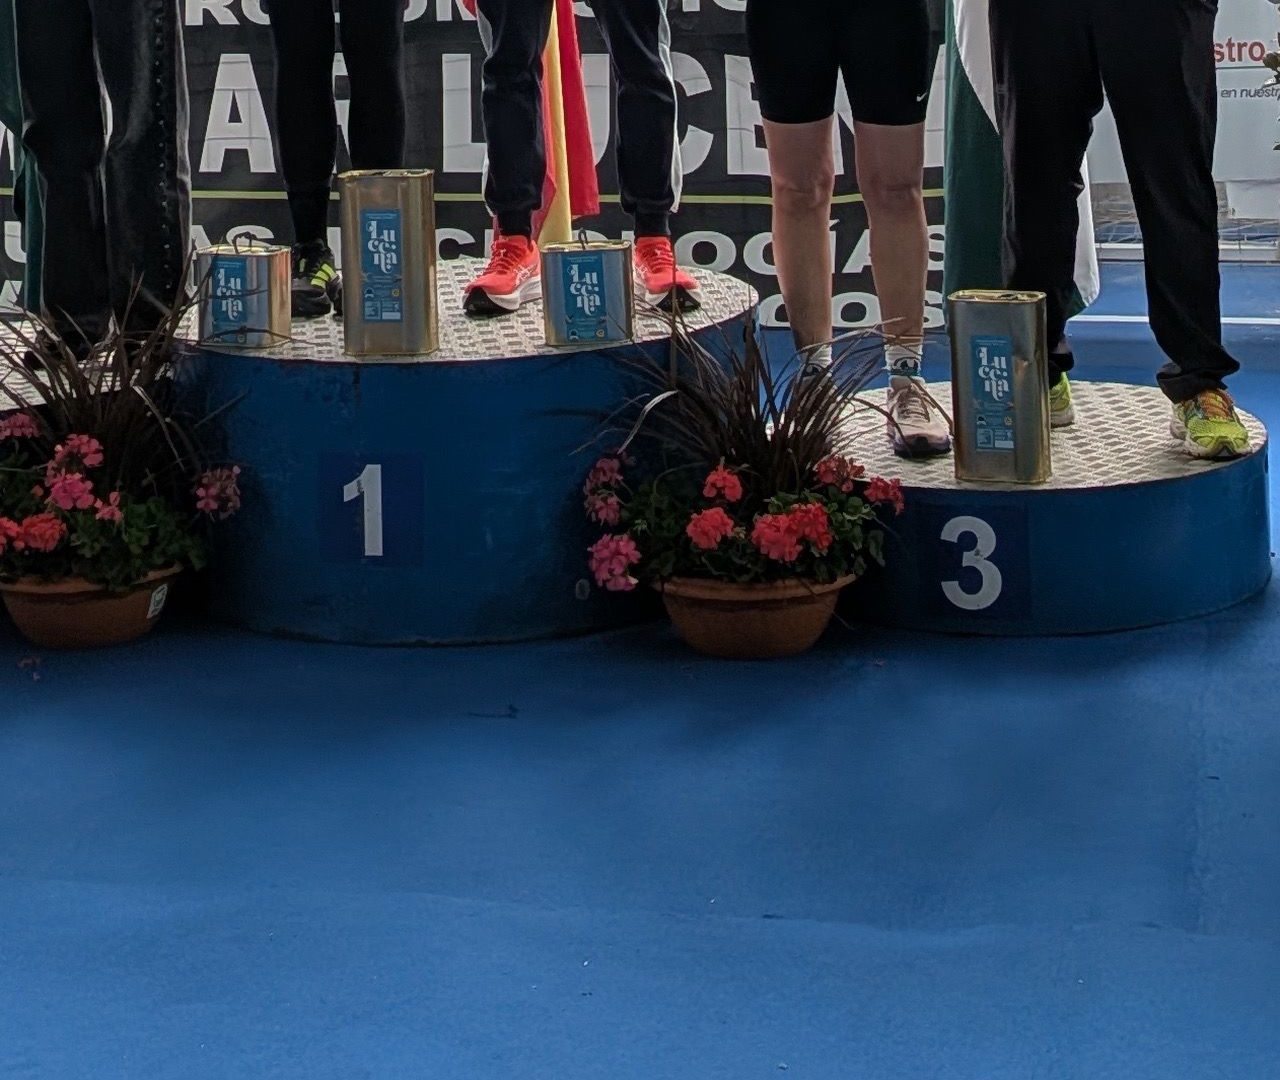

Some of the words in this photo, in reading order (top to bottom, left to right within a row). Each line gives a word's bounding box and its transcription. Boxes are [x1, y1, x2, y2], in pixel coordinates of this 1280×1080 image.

[1220, 88, 1237, 99] en
[343, 463, 384, 557] 1
[940, 515, 1003, 610] 3
